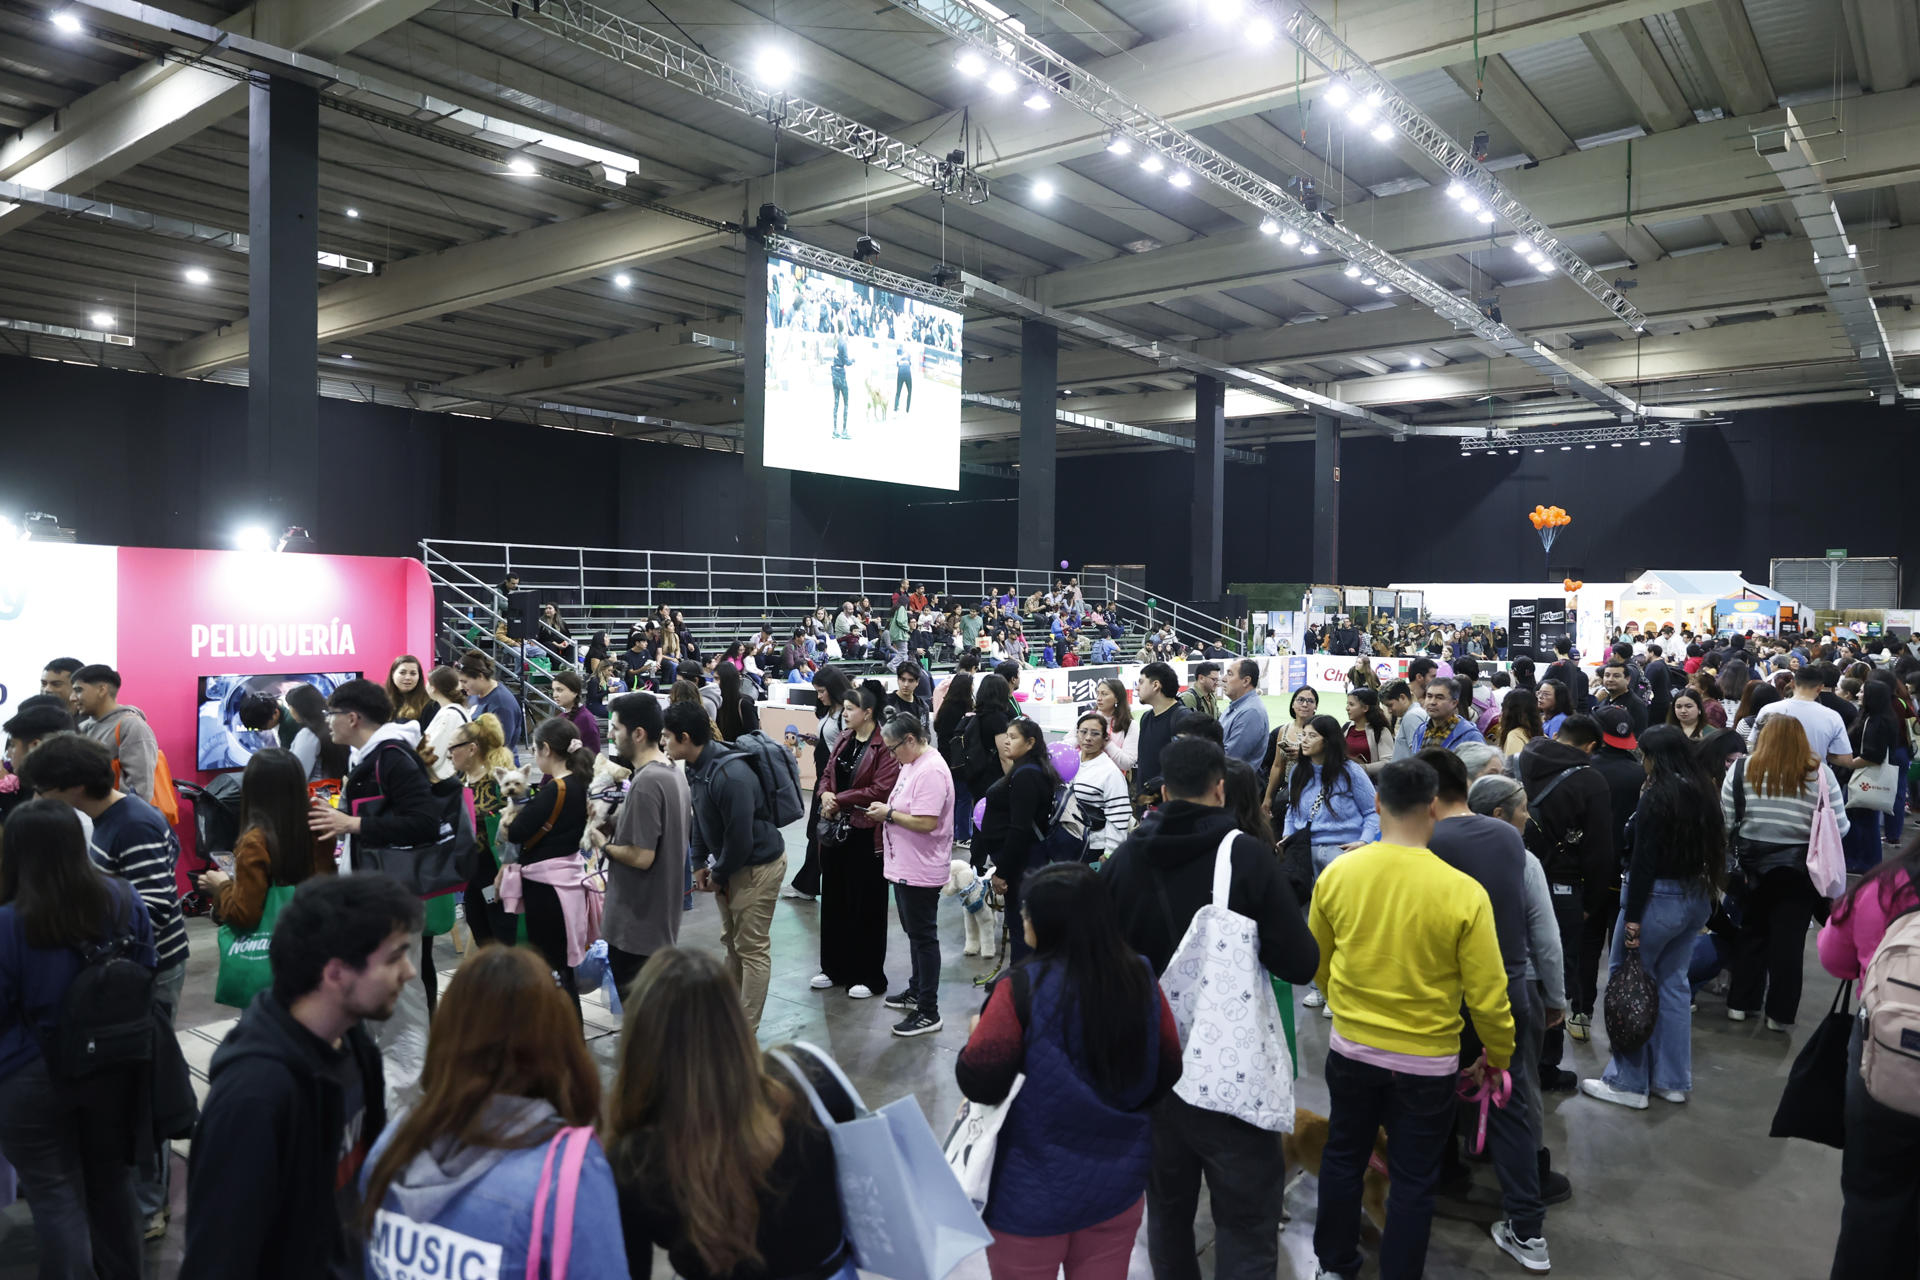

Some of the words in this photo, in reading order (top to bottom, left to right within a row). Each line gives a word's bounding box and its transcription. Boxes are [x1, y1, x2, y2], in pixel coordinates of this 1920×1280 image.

[191, 617, 356, 663] PELUQUERÍA
[1069, 678, 1102, 701] FER
[374, 1220, 486, 1280] MUSIC
